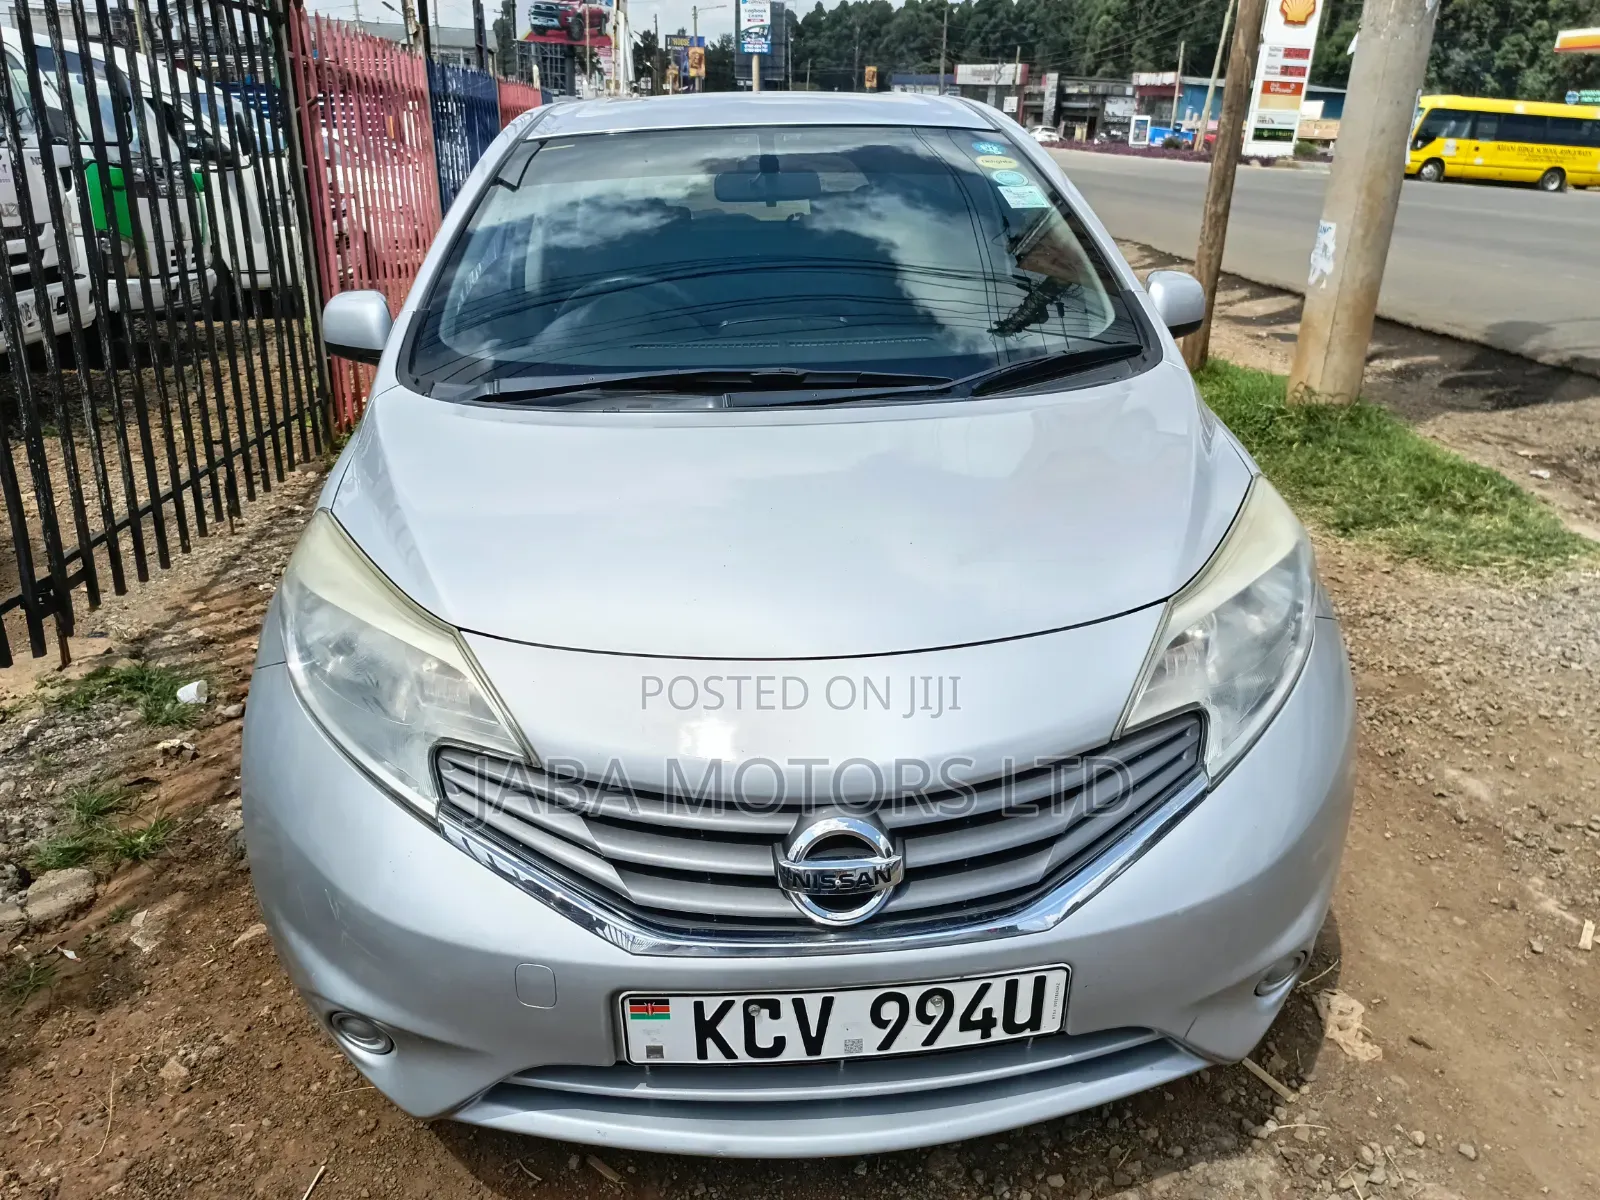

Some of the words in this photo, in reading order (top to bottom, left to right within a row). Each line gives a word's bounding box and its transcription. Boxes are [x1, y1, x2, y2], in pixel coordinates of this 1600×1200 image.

[792, 867, 893, 890] NISSAN
[693, 995, 835, 1060] KCV
[869, 974, 1047, 1051] 994U
